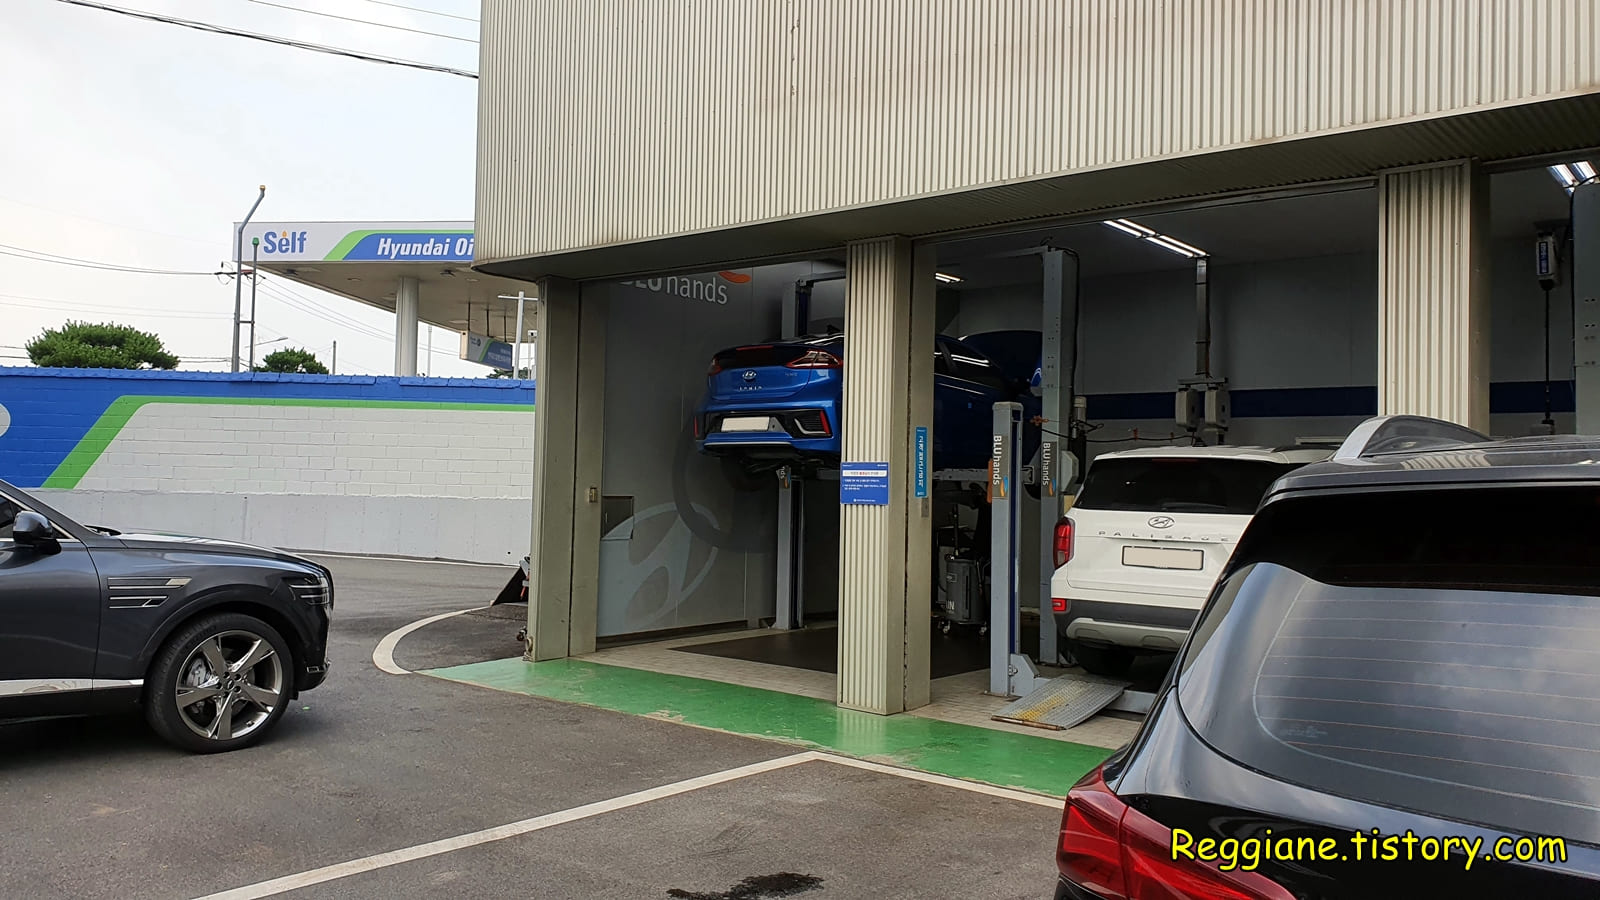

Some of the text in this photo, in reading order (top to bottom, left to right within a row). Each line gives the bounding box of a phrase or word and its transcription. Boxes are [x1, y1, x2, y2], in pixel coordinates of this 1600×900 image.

[263, 231, 307, 253] Self
[377, 237, 451, 260] Hyundai
[992, 434, 1002, 485] BLUhands
[1042, 442, 1051, 486] BLUhands
